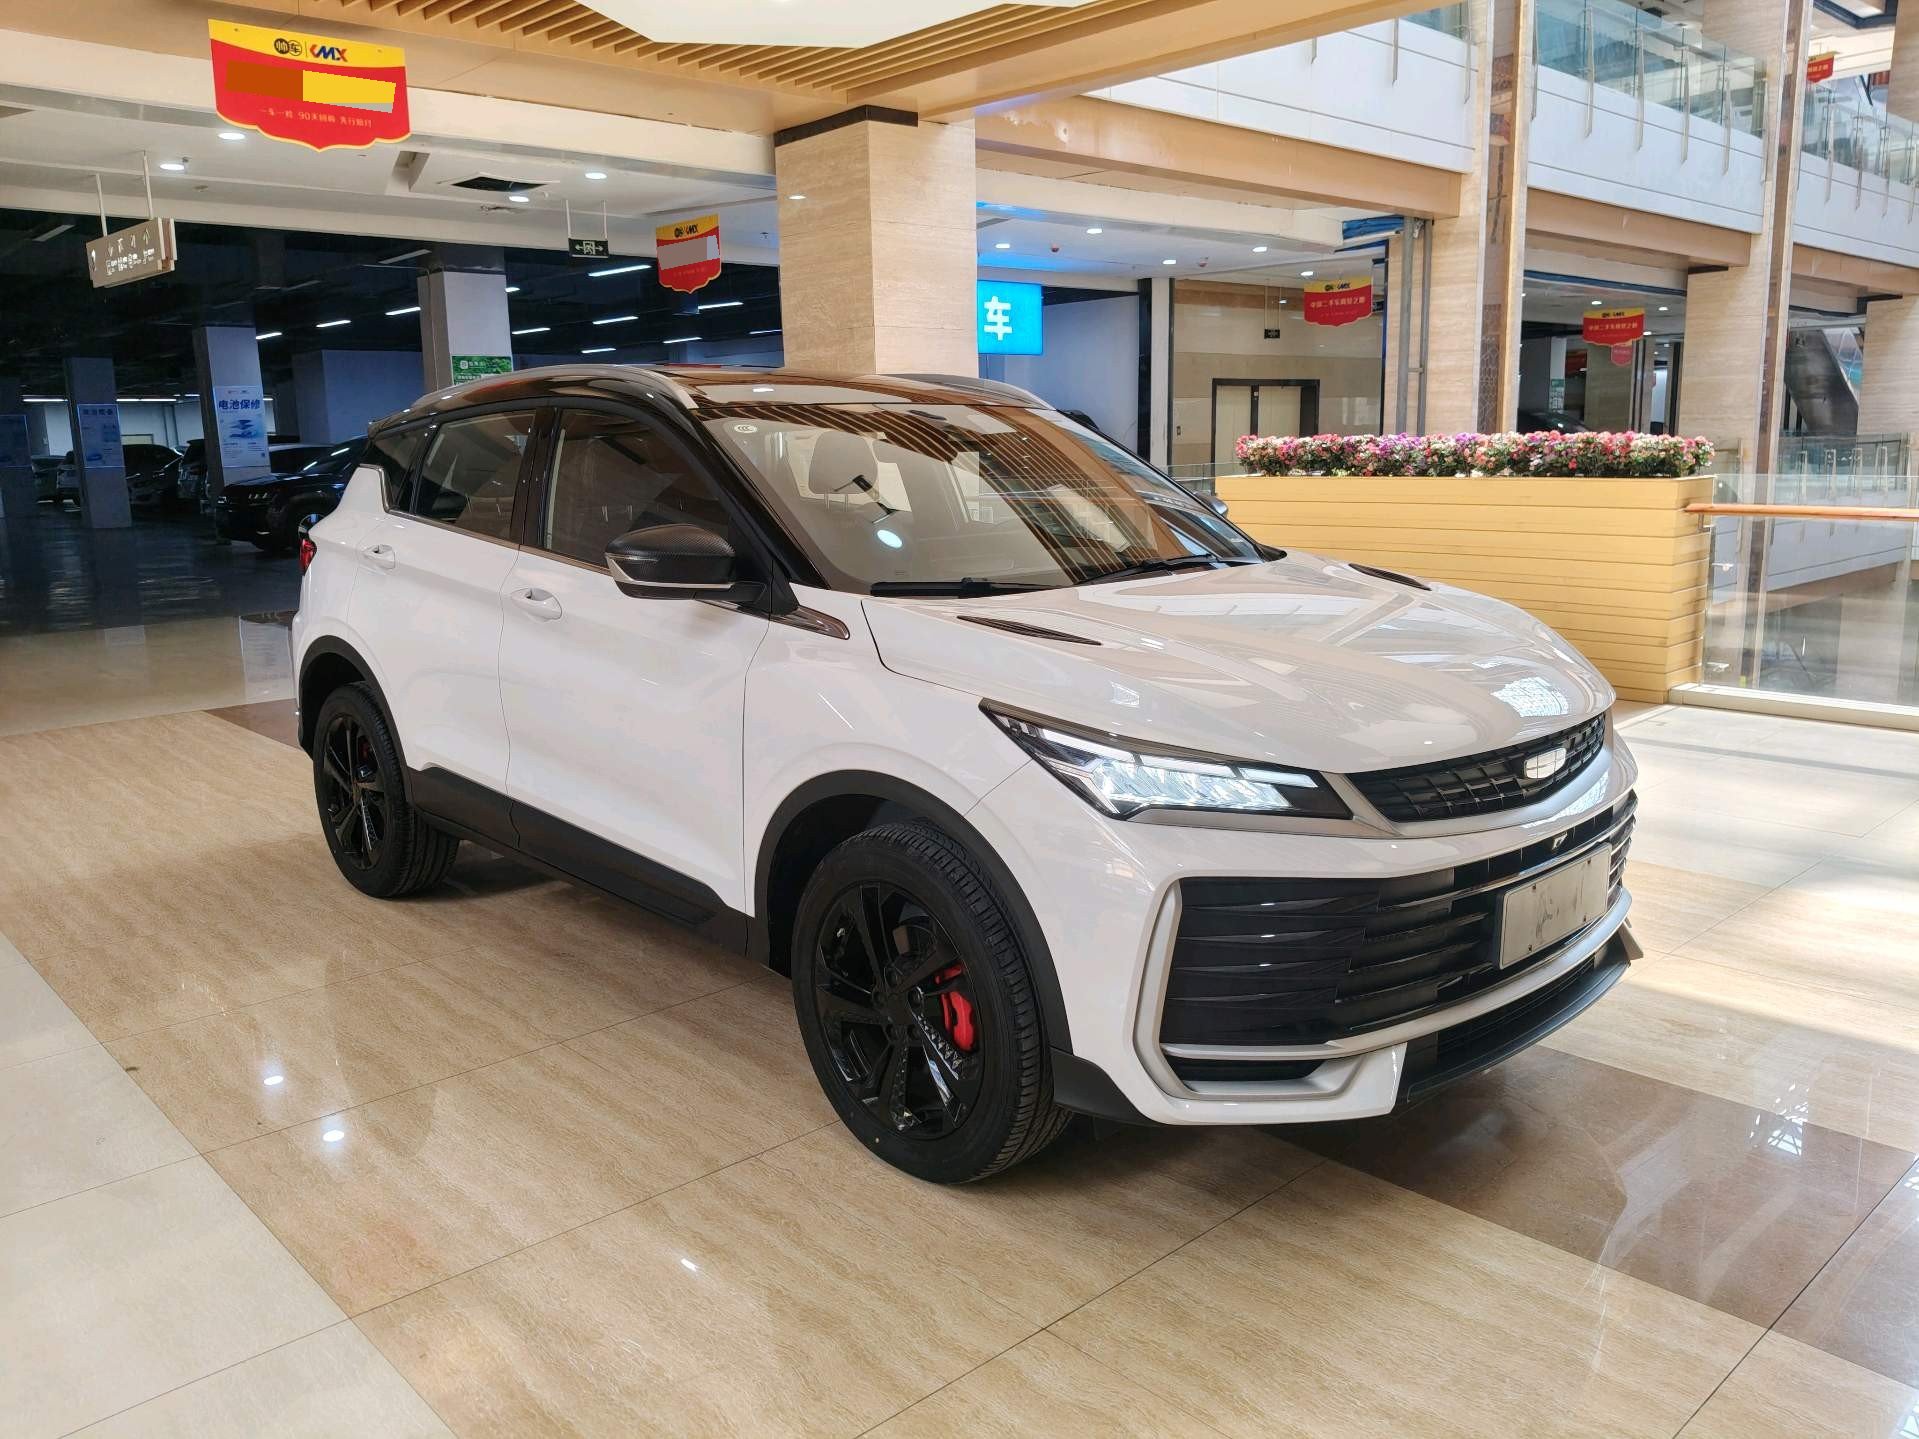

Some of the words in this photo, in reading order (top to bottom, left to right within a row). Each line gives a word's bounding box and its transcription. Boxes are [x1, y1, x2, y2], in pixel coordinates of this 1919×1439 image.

[984, 296, 1013, 341] 车
[219, 399, 260, 410] 电池保修
